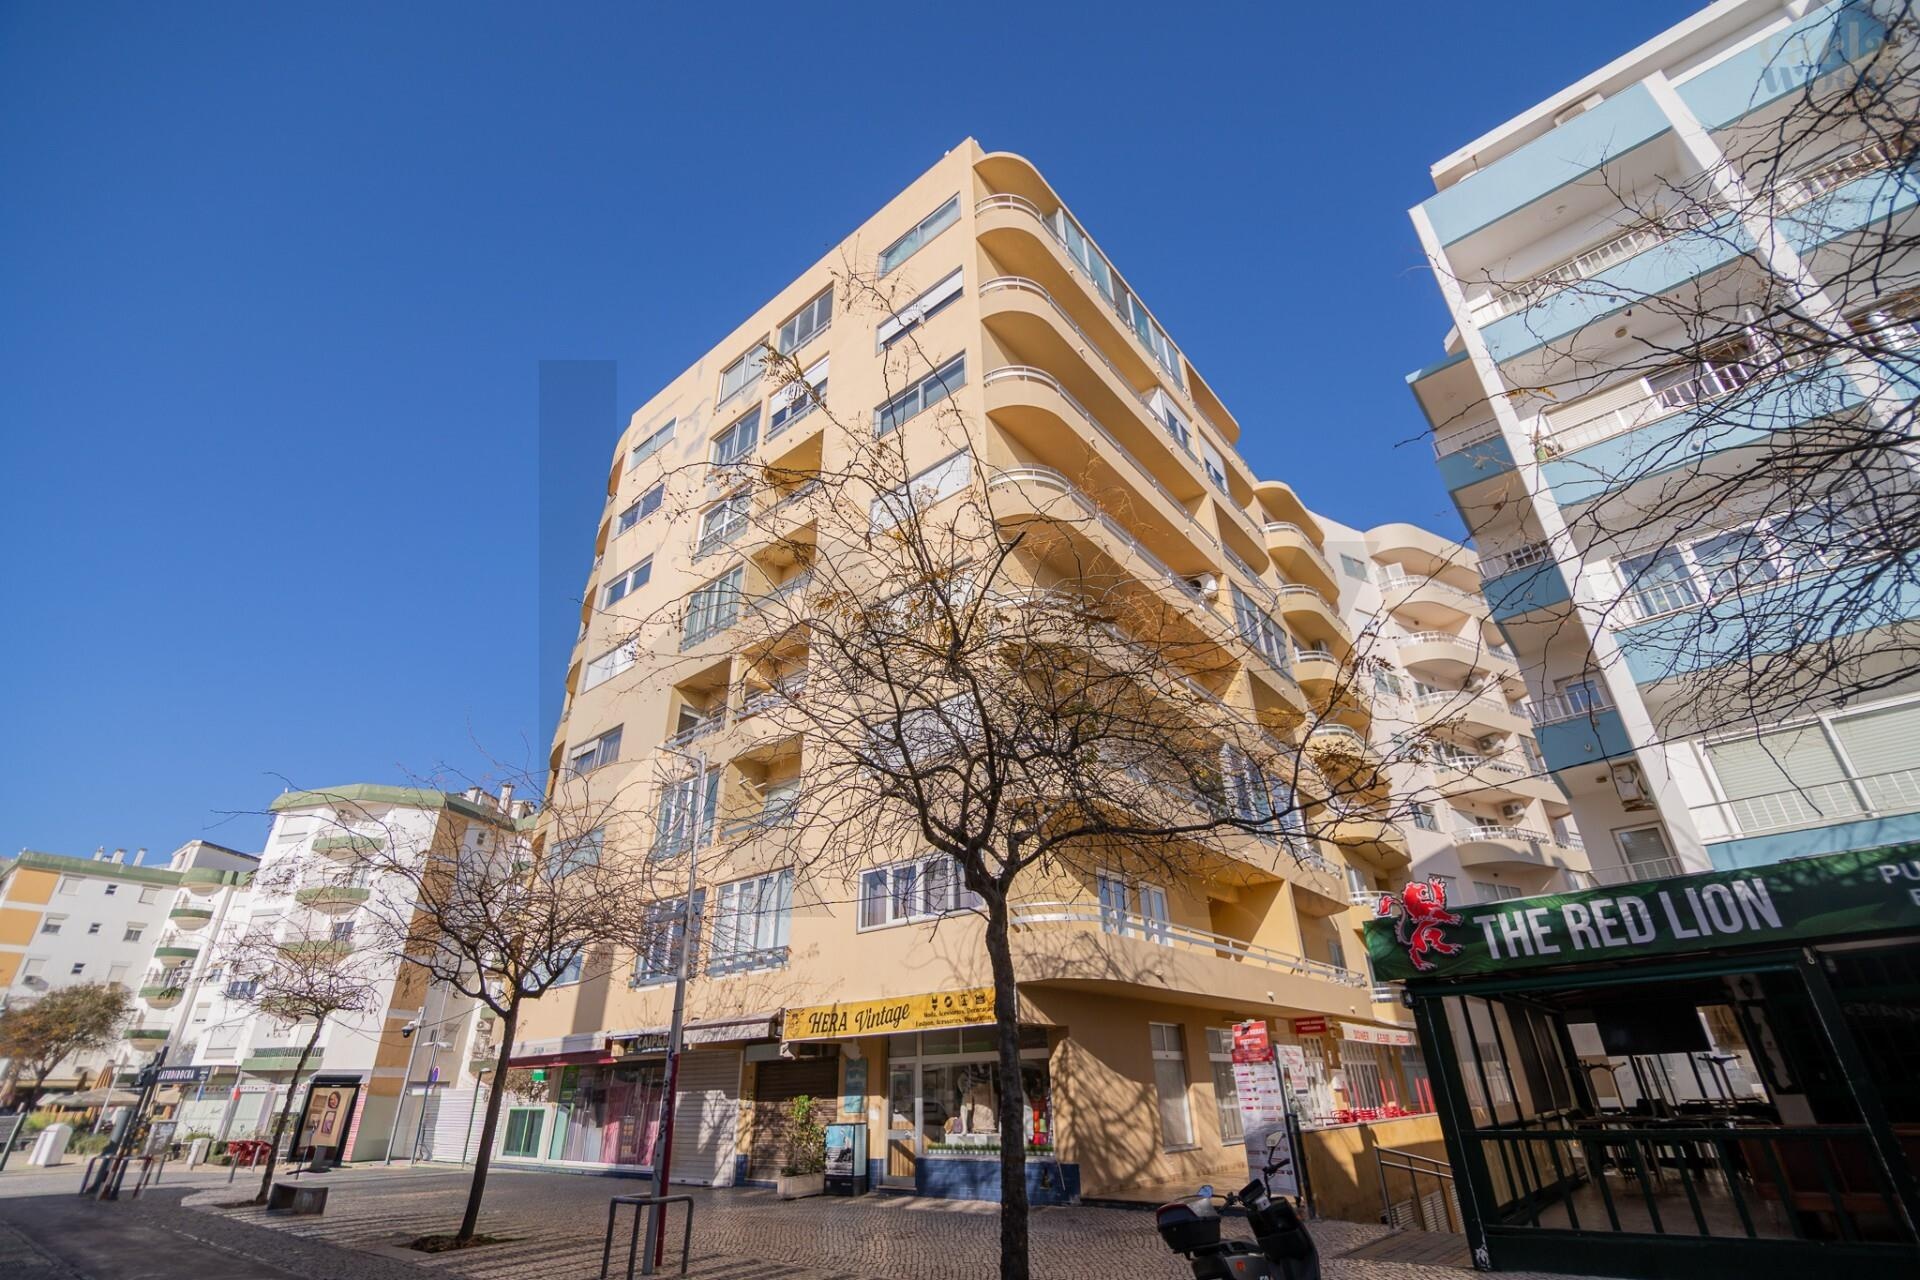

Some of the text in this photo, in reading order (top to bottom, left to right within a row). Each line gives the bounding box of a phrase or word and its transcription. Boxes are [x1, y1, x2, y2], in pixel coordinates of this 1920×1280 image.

[1472, 877, 1784, 961] THE RED LION
[808, 1003, 911, 1034] HERA Vintage
